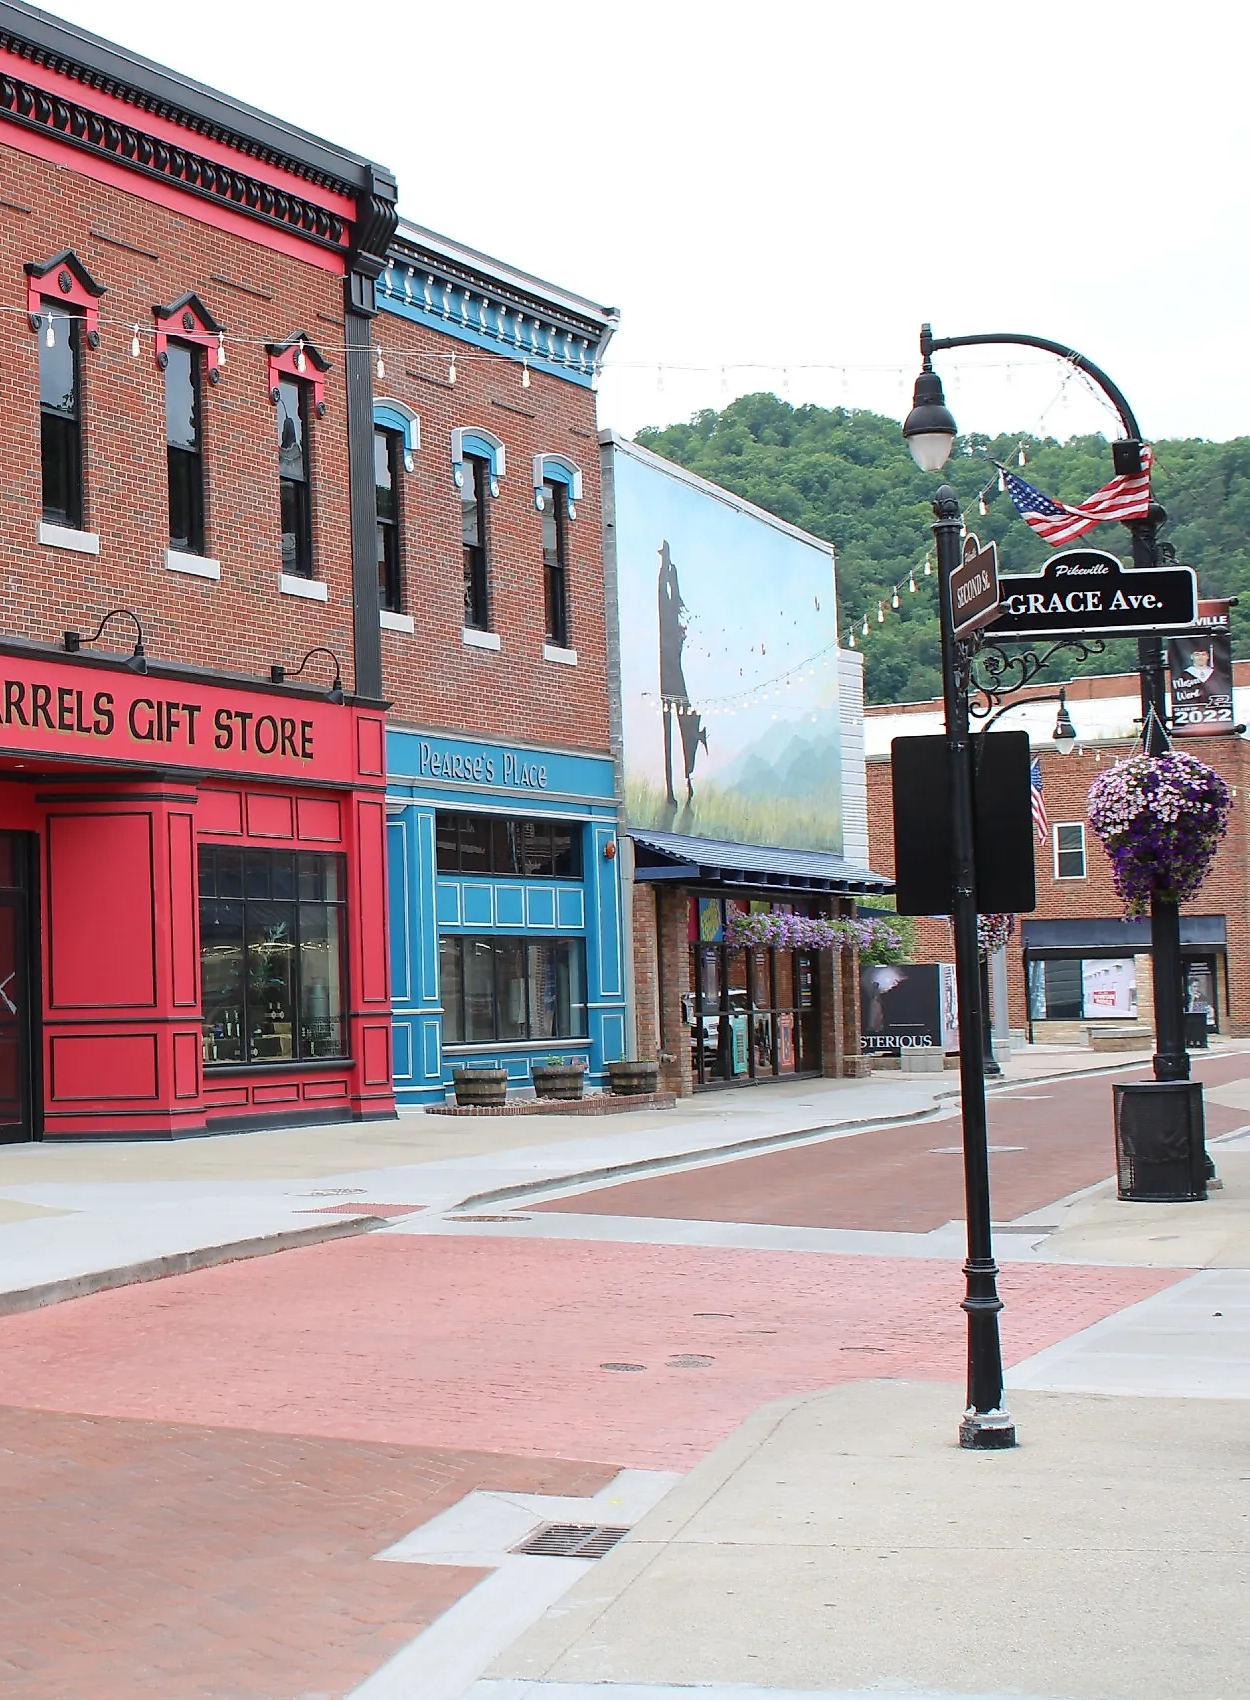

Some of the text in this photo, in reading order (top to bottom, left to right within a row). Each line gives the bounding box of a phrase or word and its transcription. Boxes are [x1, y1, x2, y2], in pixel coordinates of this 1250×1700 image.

[1055, 563, 1110, 577] Pikeville
[957, 574, 982, 608] SECOND
[1007, 590, 1163, 615] GRACE Ave.
[1174, 708, 1233, 724] 2022
[128, 698, 202, 746] GIFT
[214, 709, 314, 760] STORE
